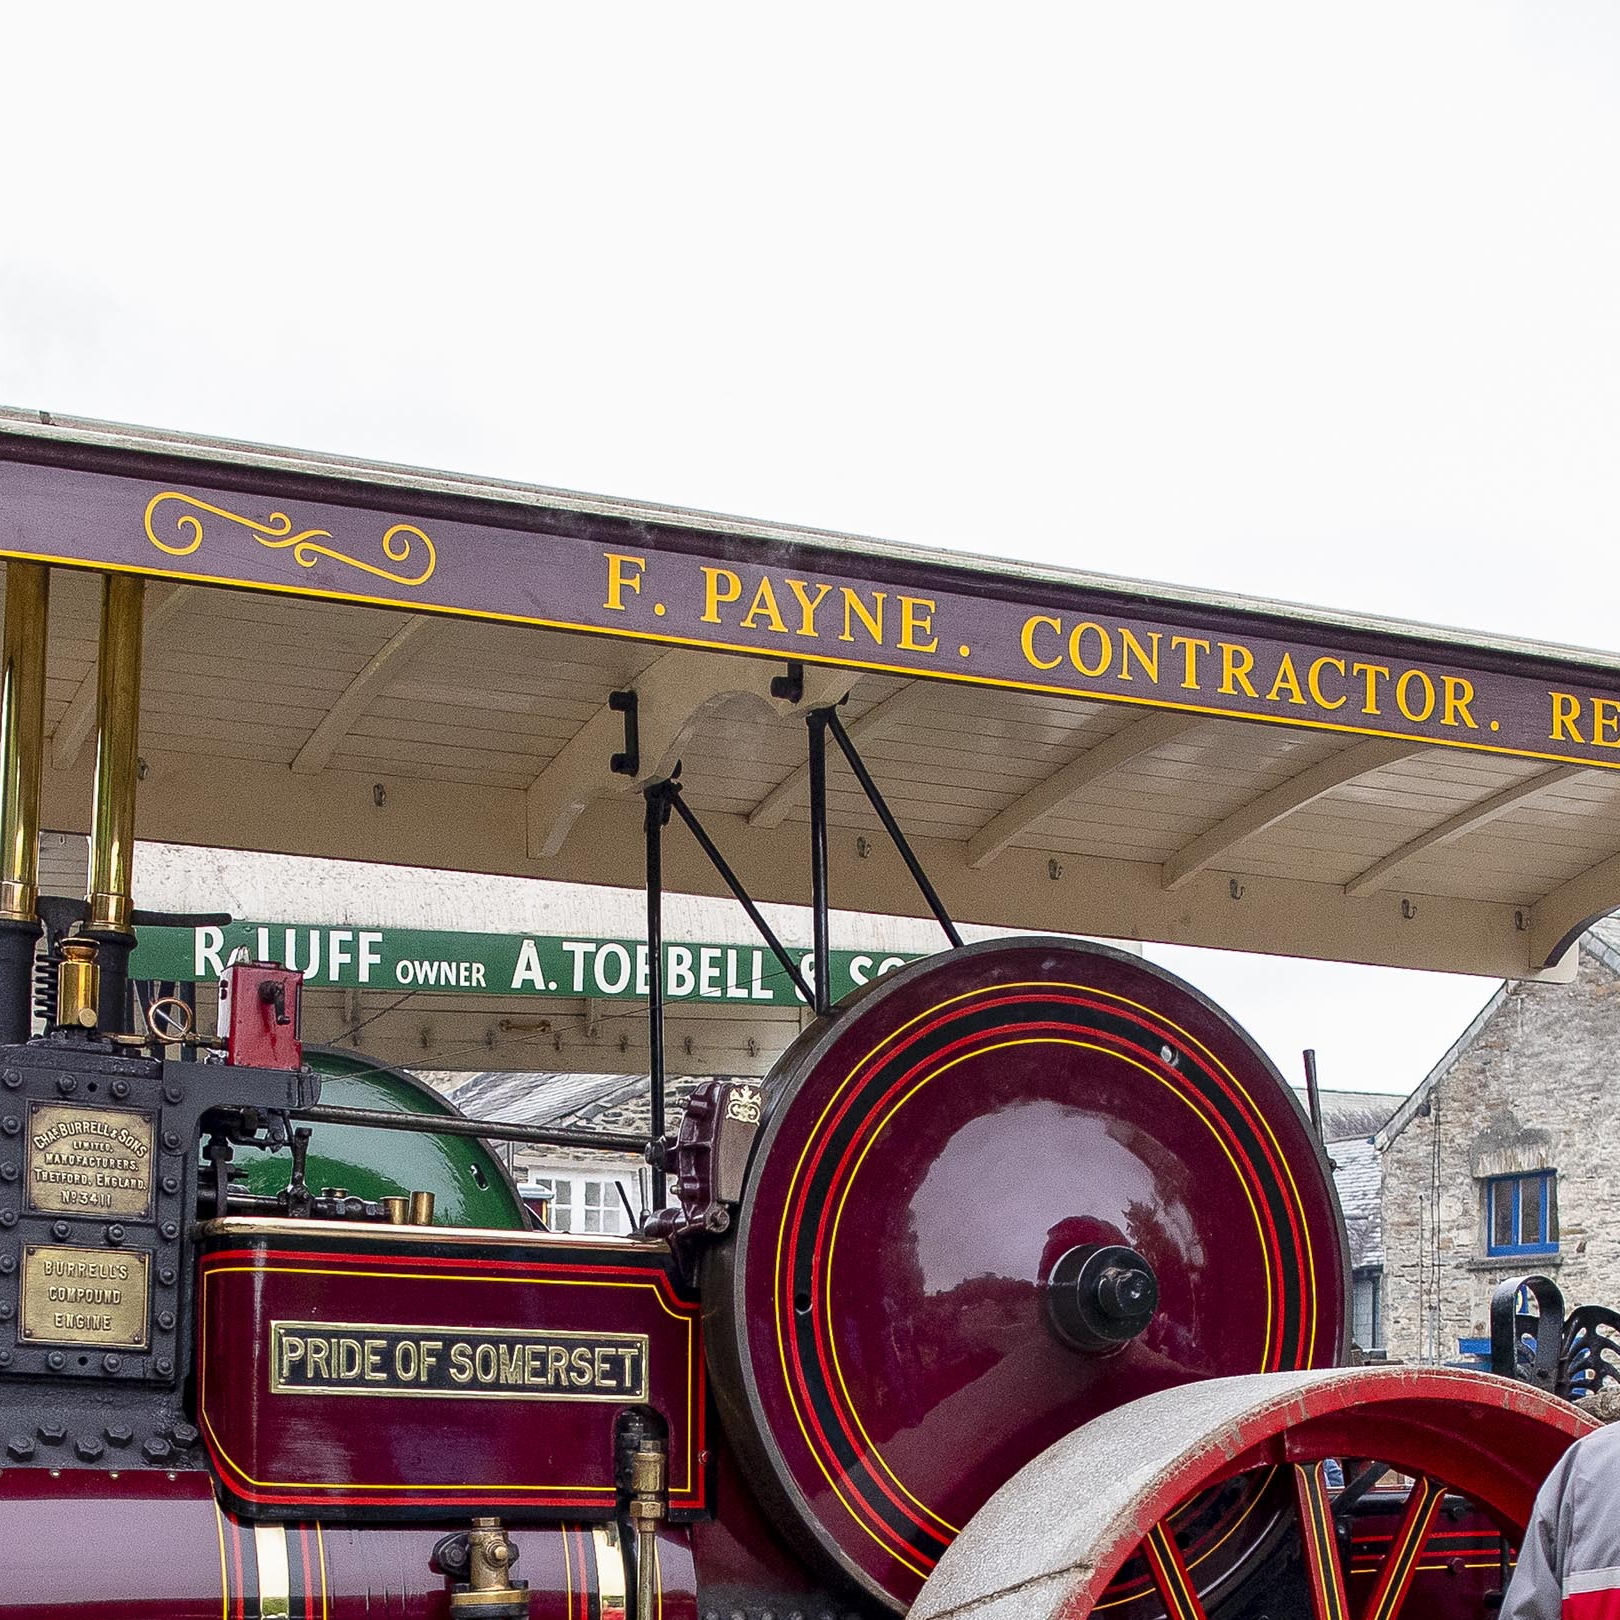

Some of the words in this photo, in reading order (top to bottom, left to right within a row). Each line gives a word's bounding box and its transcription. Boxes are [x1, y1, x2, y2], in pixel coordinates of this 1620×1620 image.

[602, 552, 667, 617] F.
[1021, 615, 1500, 732] CONTRACTOR.
[395, 960, 487, 988] OWNER
[58, 1120, 111, 1138] BURRELL
[110, 1128, 119, 1140] &
[117, 1128, 149, 1158] SONS
[79, 1191, 112, 1208] 3411
[43, 1260, 129, 1281] BURRELL'S
[49, 1286, 122, 1306] COMPOUND
[54, 1312, 112, 1331] ENGINE
[281, 1336, 388, 1382] PRIDE
[394, 1339, 444, 1383] OF
[449, 1342, 642, 1389] SOMERSET
